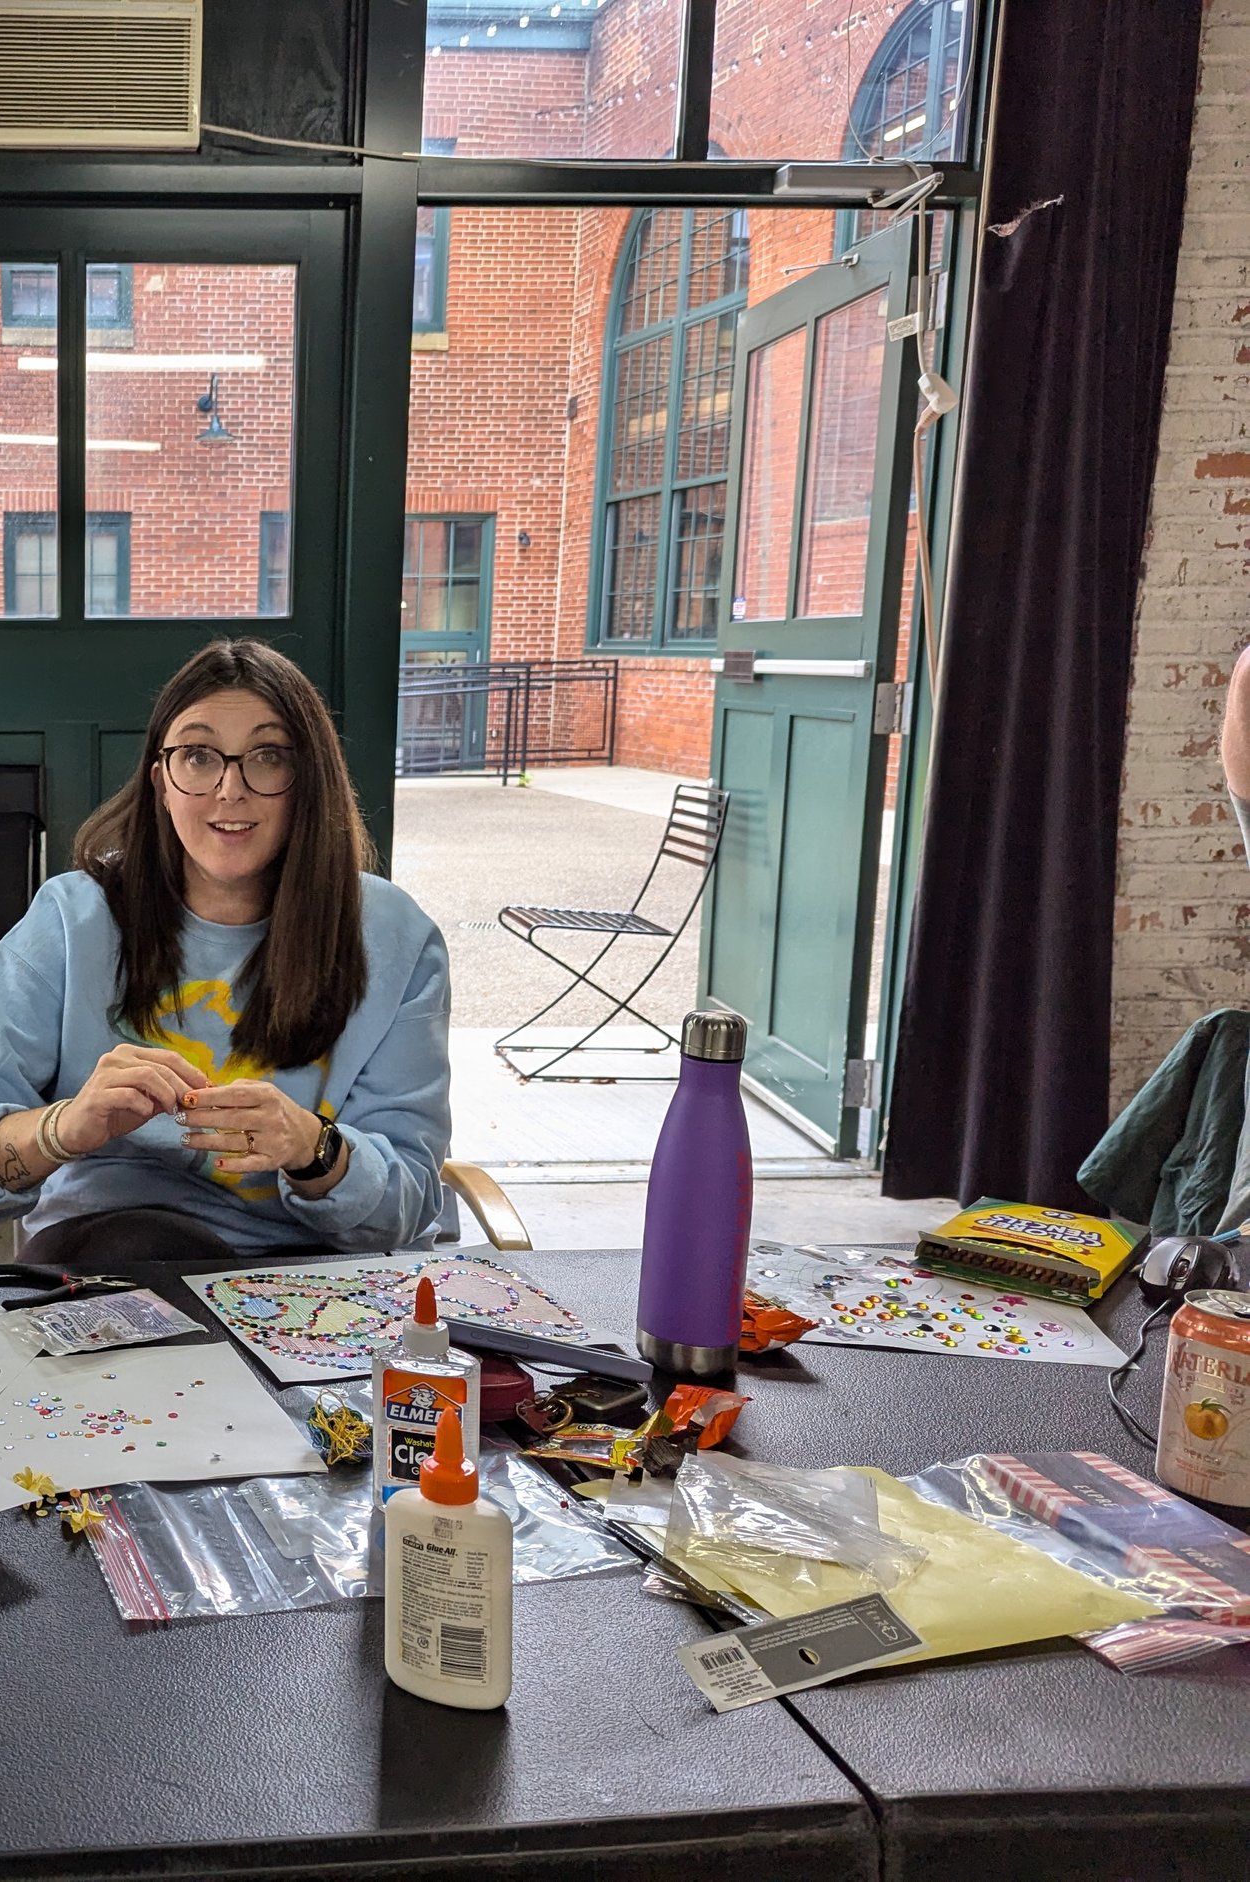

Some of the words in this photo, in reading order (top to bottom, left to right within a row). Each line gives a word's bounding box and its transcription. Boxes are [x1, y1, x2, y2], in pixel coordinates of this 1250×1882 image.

[977, 1217, 1105, 1247] COLORED
[989, 1213, 1102, 1240] PENCILS
[1168, 1342, 1250, 1387] WATERL
[390, 1404, 459, 1423] ELME
[394, 1444, 429, 1465] Cle
[404, 1437, 435, 1448] Washab
